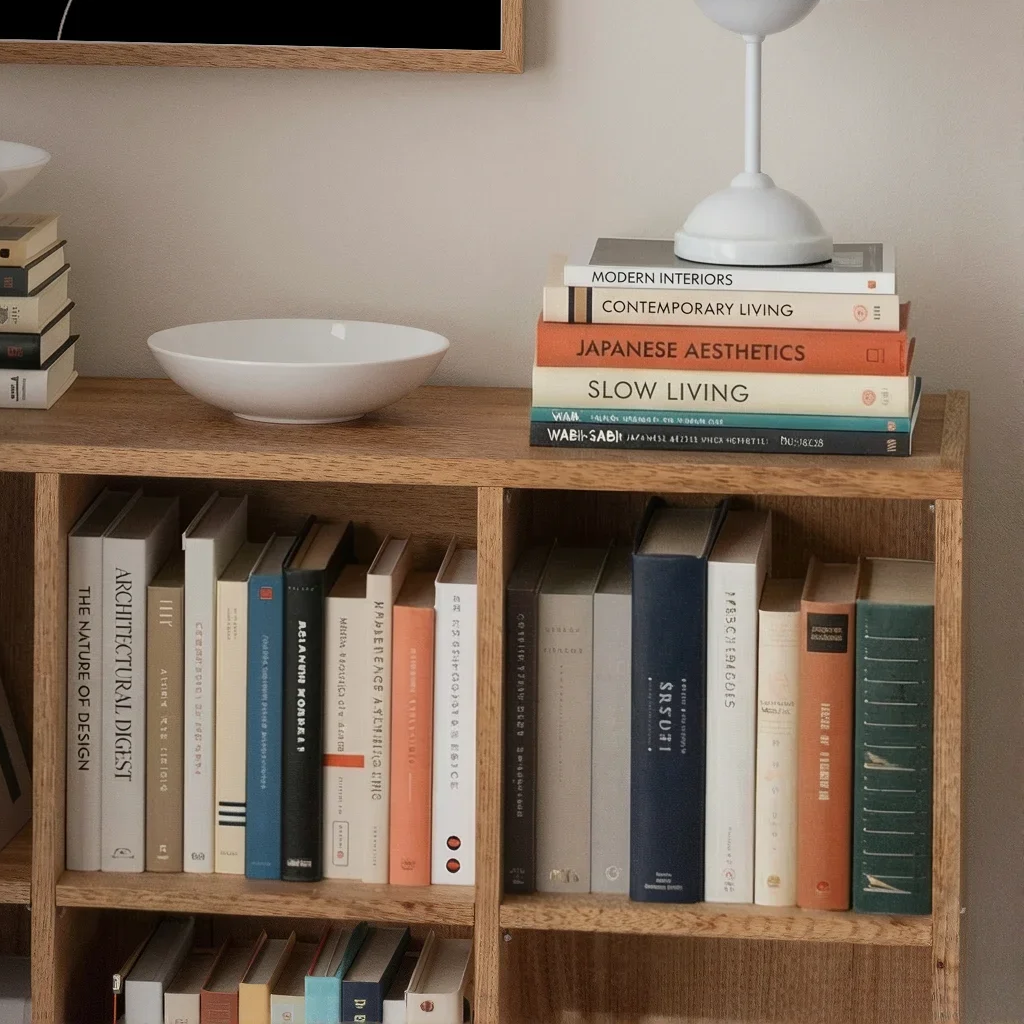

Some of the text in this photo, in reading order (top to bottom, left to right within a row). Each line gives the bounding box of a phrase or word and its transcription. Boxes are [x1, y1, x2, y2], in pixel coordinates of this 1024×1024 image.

[591, 271, 733, 286] MODERN INTERIORS
[602, 300, 794, 317] CONTEMPORARY LIVING
[576, 339, 805, 361] JAPANESE AESTHETICS
[588, 380, 749, 402] SLOW LIVING
[114, 567, 132, 715] ARCHITECTURAL
[77, 586, 91, 771] THE NATURE OF DESIGN
